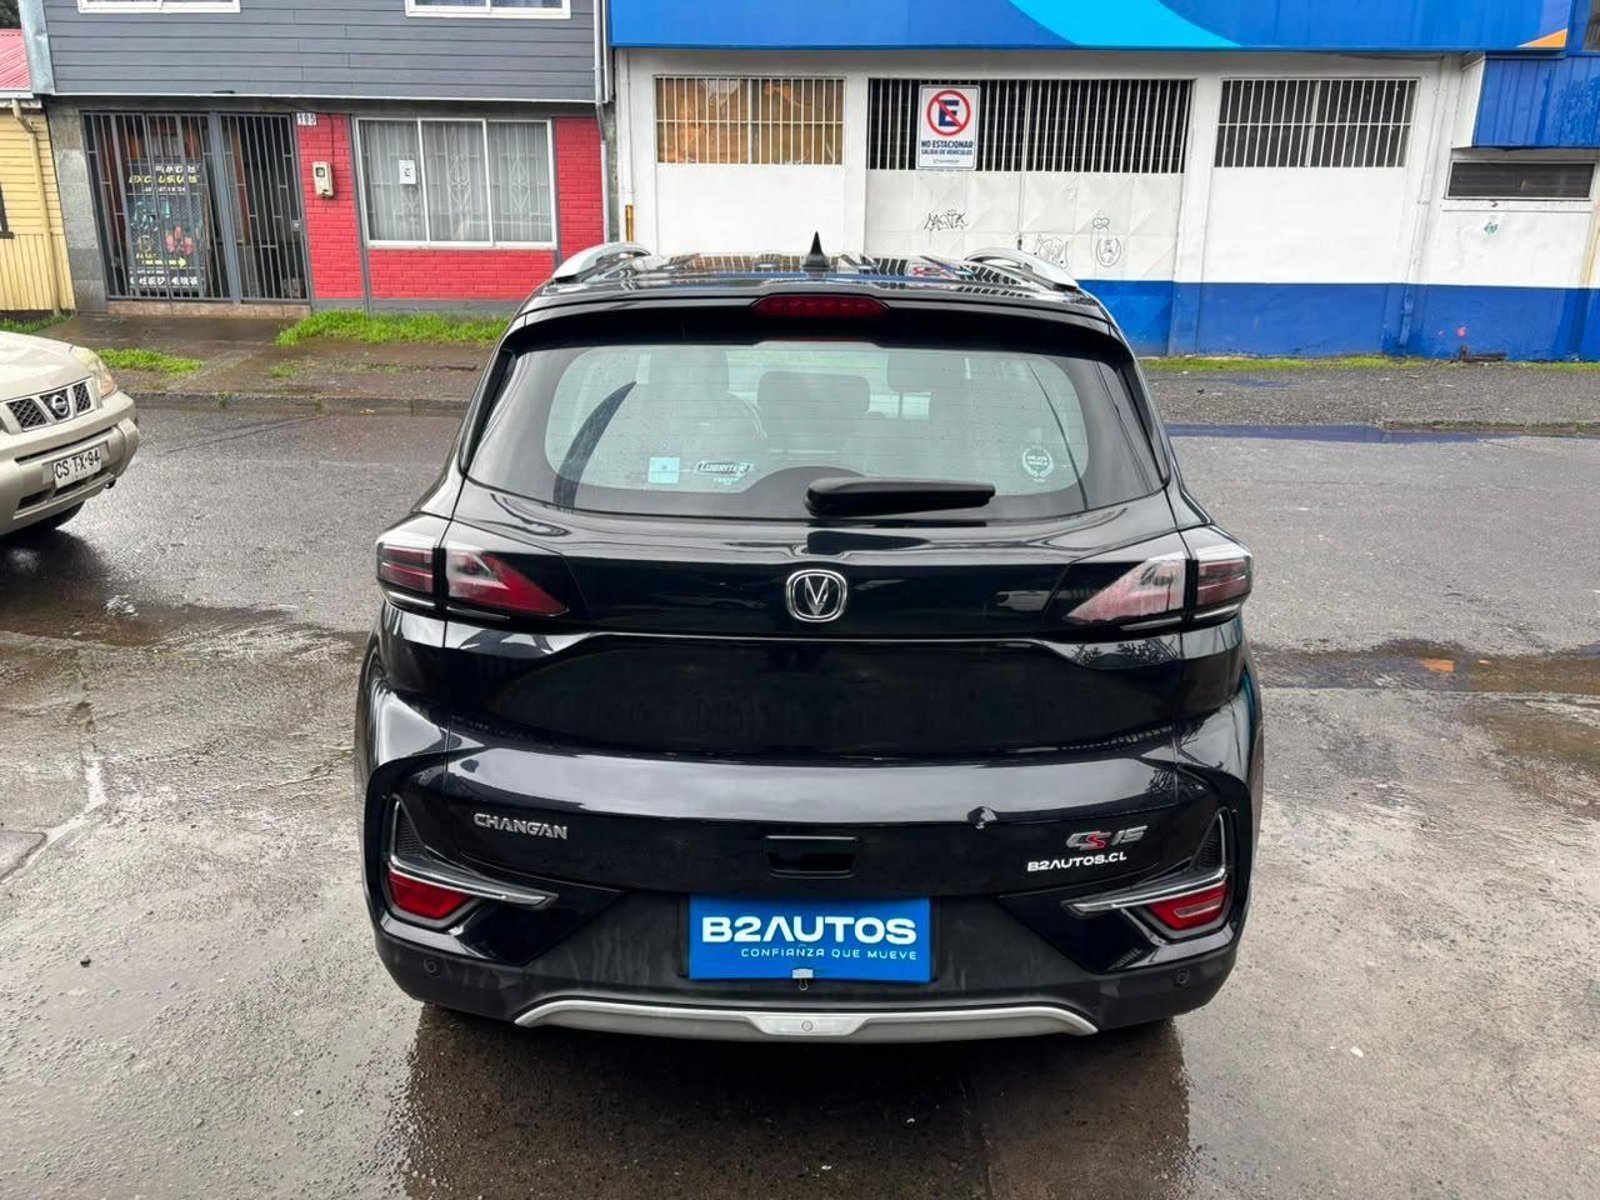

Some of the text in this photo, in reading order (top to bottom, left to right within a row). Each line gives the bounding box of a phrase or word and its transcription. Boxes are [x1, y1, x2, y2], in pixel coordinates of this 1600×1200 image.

[921, 140, 974, 149] NO ESTACIONAR
[473, 813, 568, 840] CHANGAN
[1027, 852, 1127, 872] B2AUTOS.CL
[702, 916, 917, 945] B2AUTOS
[741, 948, 917, 961] CONFIANZA QUE MUEVE
